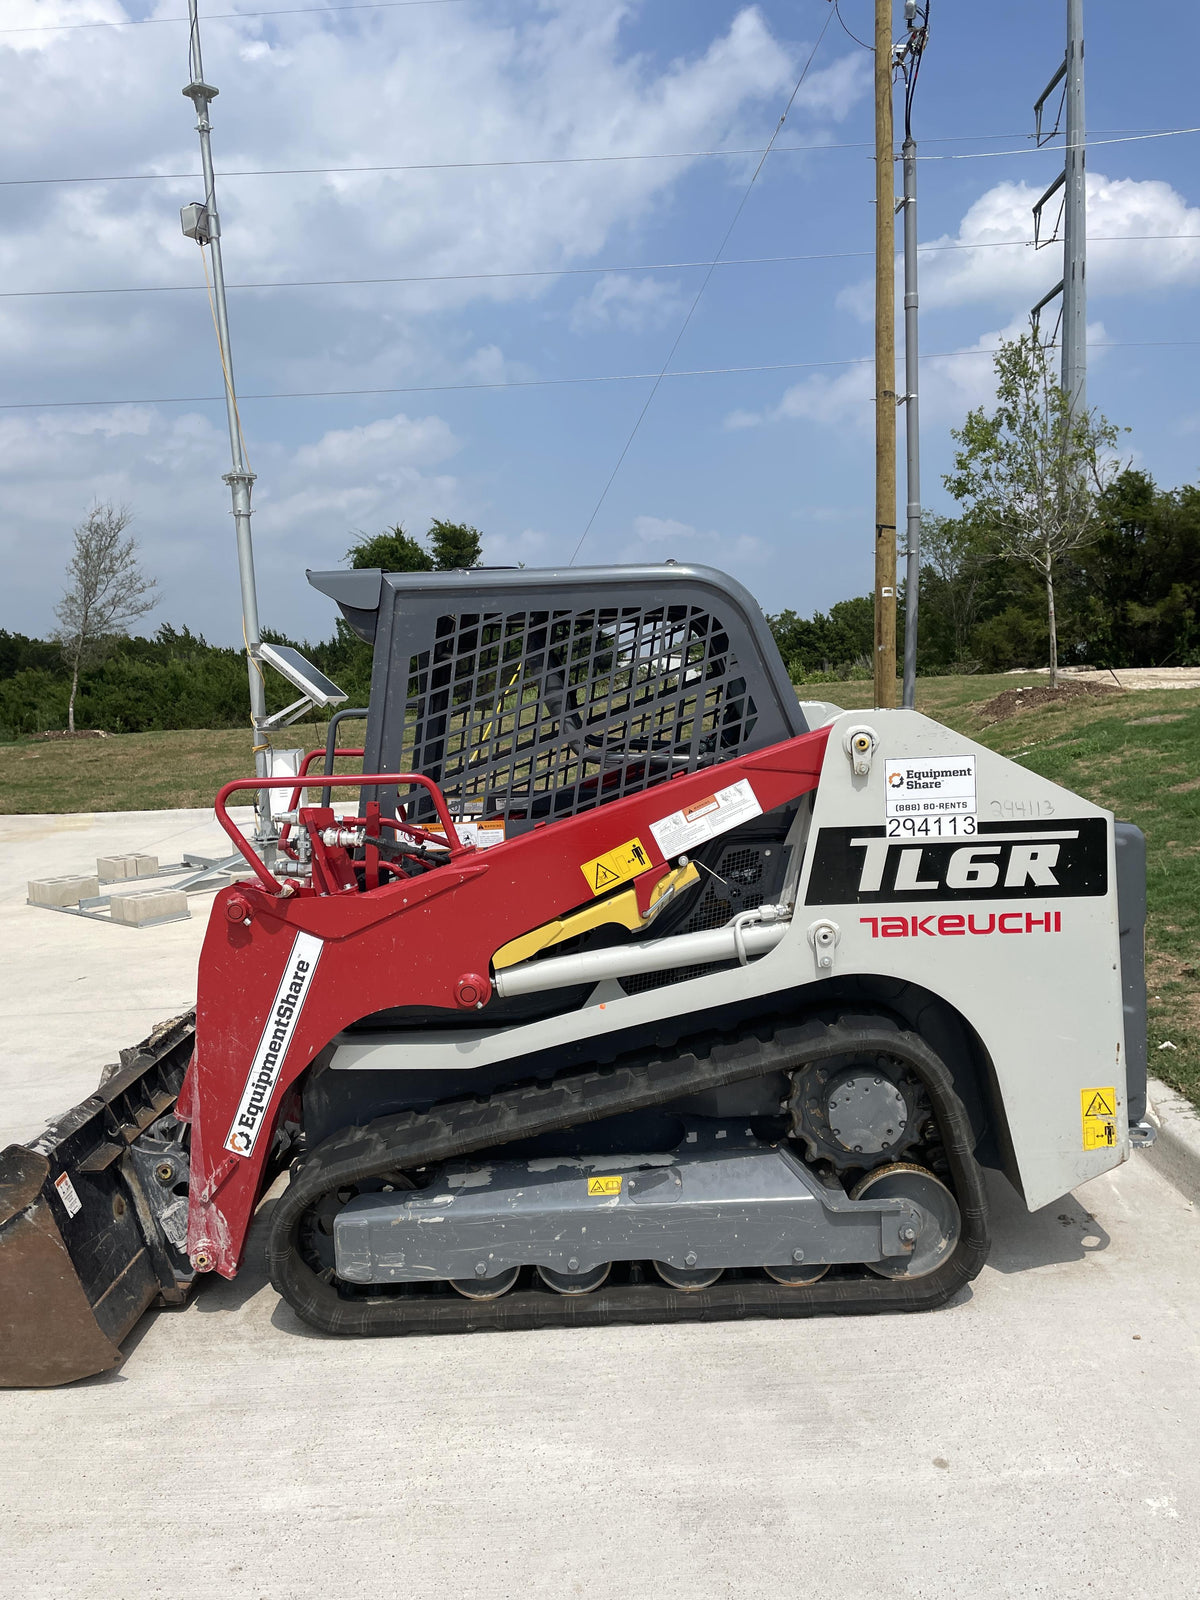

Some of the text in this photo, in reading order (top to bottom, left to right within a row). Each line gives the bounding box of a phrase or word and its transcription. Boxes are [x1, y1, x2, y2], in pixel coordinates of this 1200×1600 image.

[906, 767, 972, 780] Equipment
[906, 780, 941, 790] Share
[895, 801, 968, 812] (888) 80-RENTS
[888, 816, 976, 836] 294113
[850, 831, 1079, 892] TL6R
[238, 959, 310, 1131] EquipmentShare
